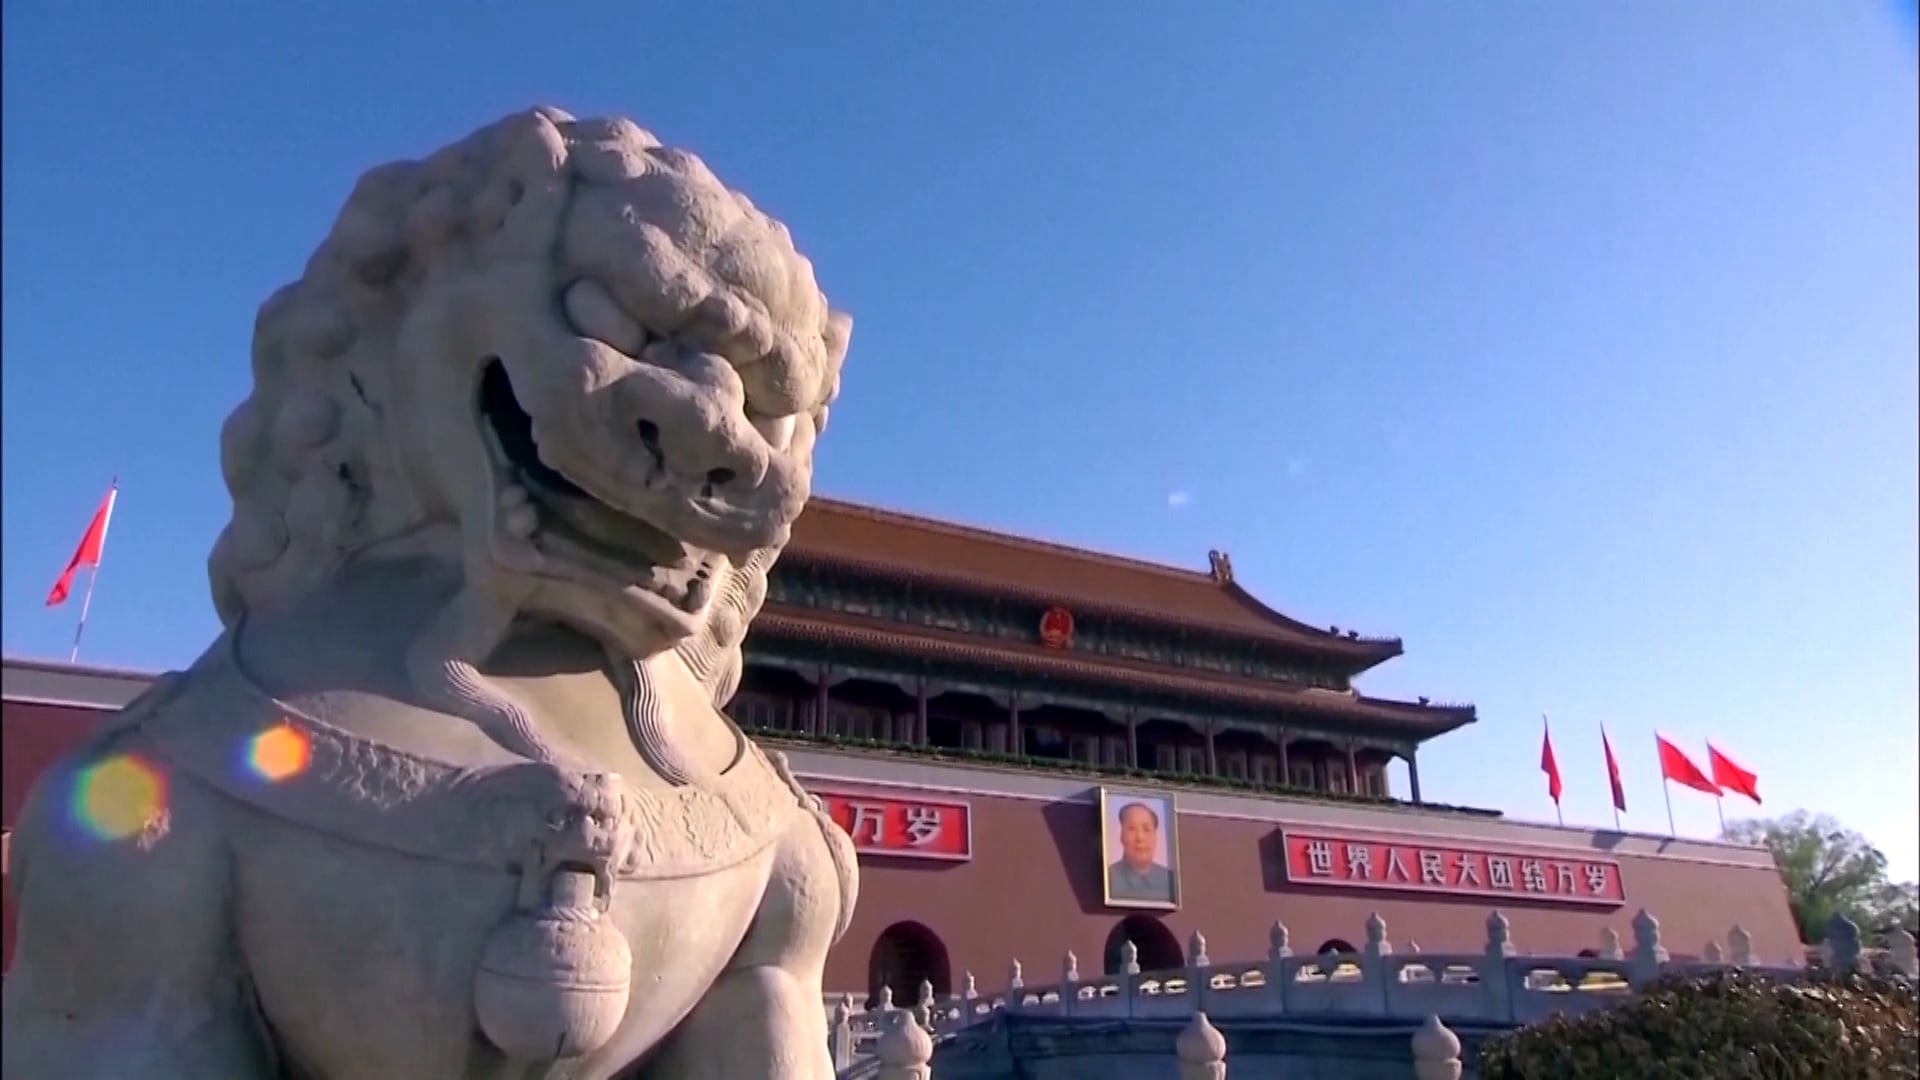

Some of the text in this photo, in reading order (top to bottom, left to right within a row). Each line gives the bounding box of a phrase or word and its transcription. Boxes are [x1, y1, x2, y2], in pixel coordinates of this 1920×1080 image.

[822, 800, 941, 845] 万岁
[1306, 841, 1607, 894] 世界人民大团结万岁
